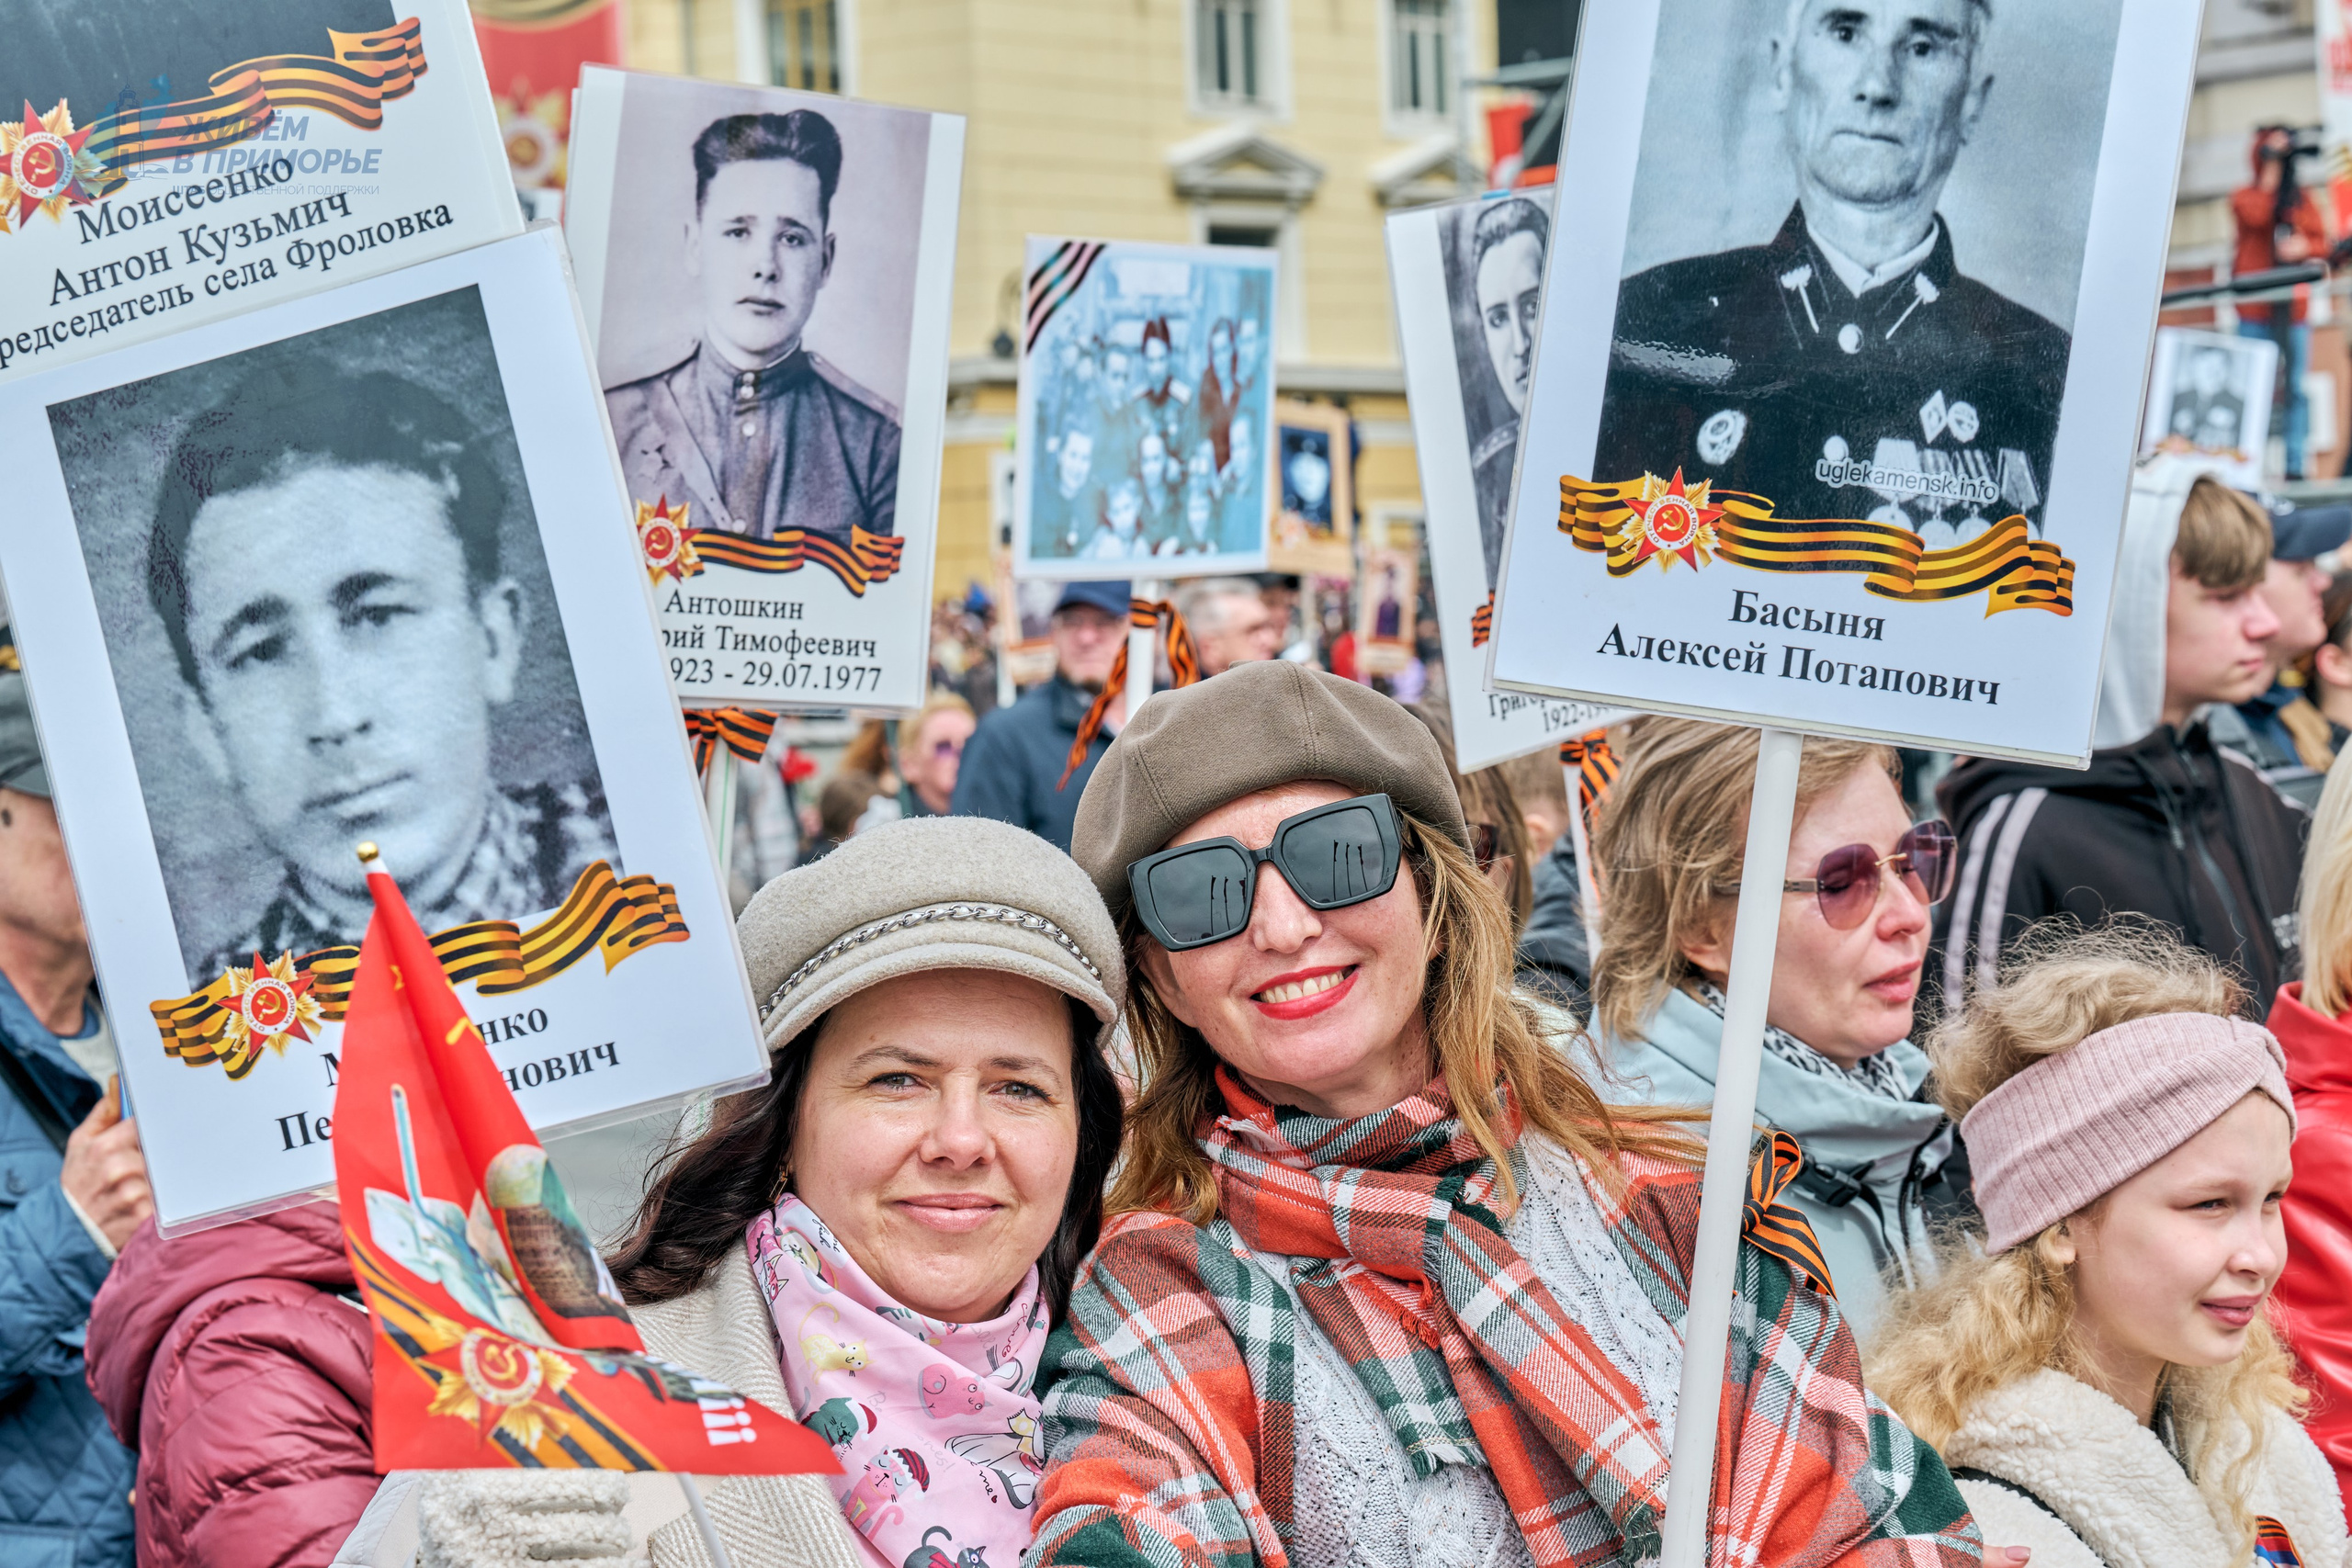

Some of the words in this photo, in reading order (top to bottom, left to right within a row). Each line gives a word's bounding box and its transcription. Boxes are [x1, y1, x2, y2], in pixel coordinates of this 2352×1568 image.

[74, 157, 293, 244] Моисеенко
[49, 246, 173, 306] Антон
[179, 193, 353, 265] Кузьмич
[0, 283, 194, 368] редседатель
[204, 258, 278, 296] села
[286, 204, 454, 272] Фроловка
[1818, 461, 1996, 500] uglekamensk.info
[663, 588, 804, 620] Антошкин
[1727, 589, 1886, 641] Басыня
[716, 625, 876, 660] Тимофеевич
[1596, 623, 1769, 675] Алексей
[1777, 644, 2001, 705] Потапович
[742, 660, 882, 692] 29.07.1977
